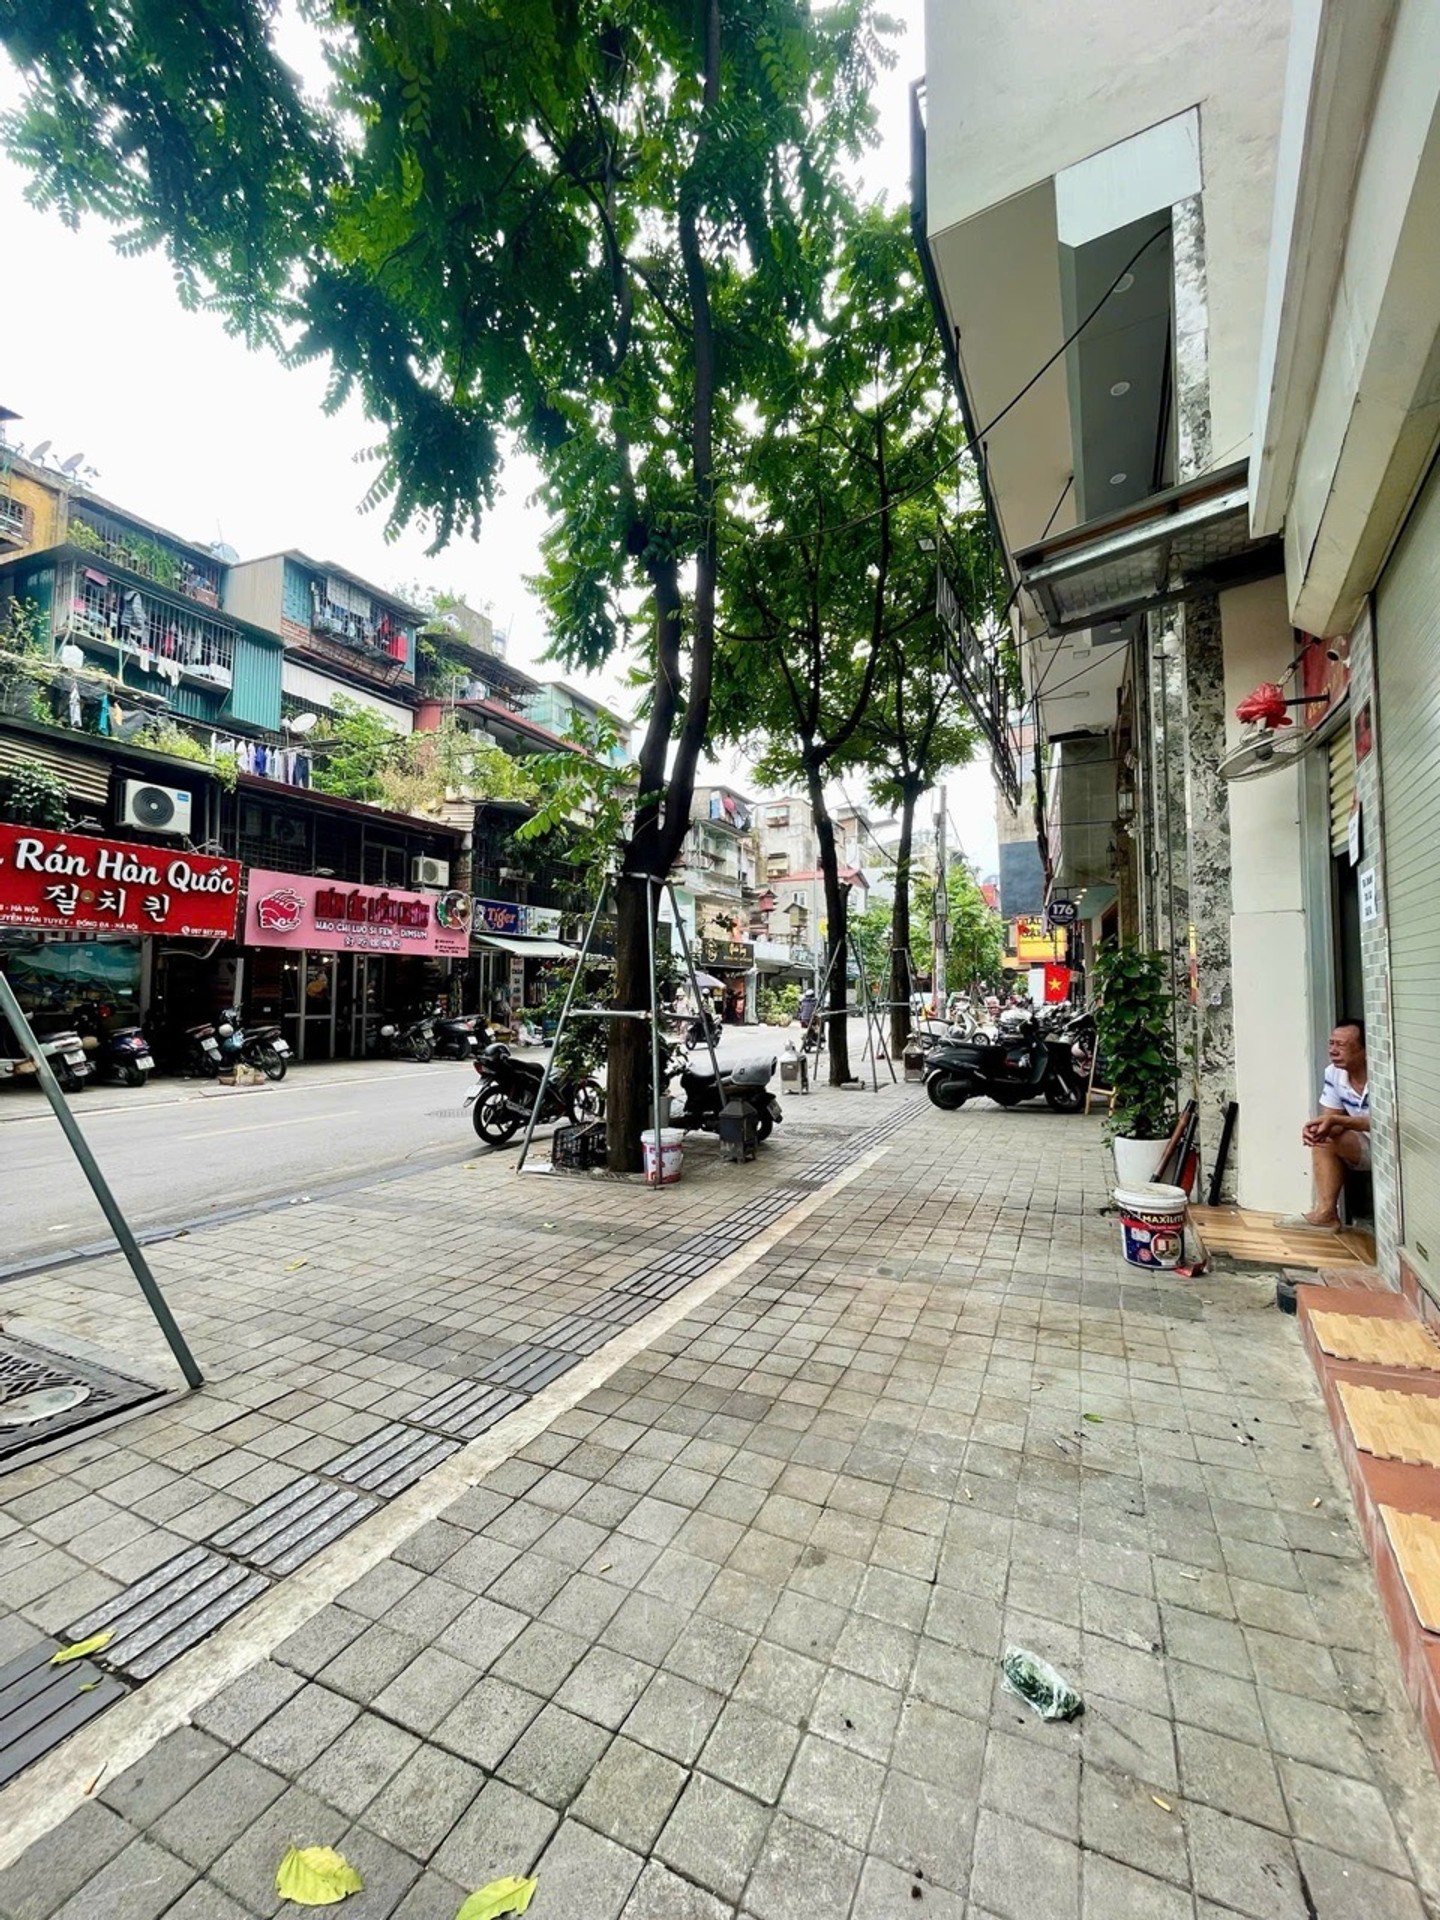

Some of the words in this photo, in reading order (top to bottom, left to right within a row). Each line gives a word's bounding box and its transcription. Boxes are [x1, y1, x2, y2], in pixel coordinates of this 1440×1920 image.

[15, 838, 91, 877] Rán
[97, 848, 161, 886] Hàn
[167, 861, 236, 894] Quốc
[487, 906, 516, 929] Tiger
[1052, 904, 1074, 915] 176
